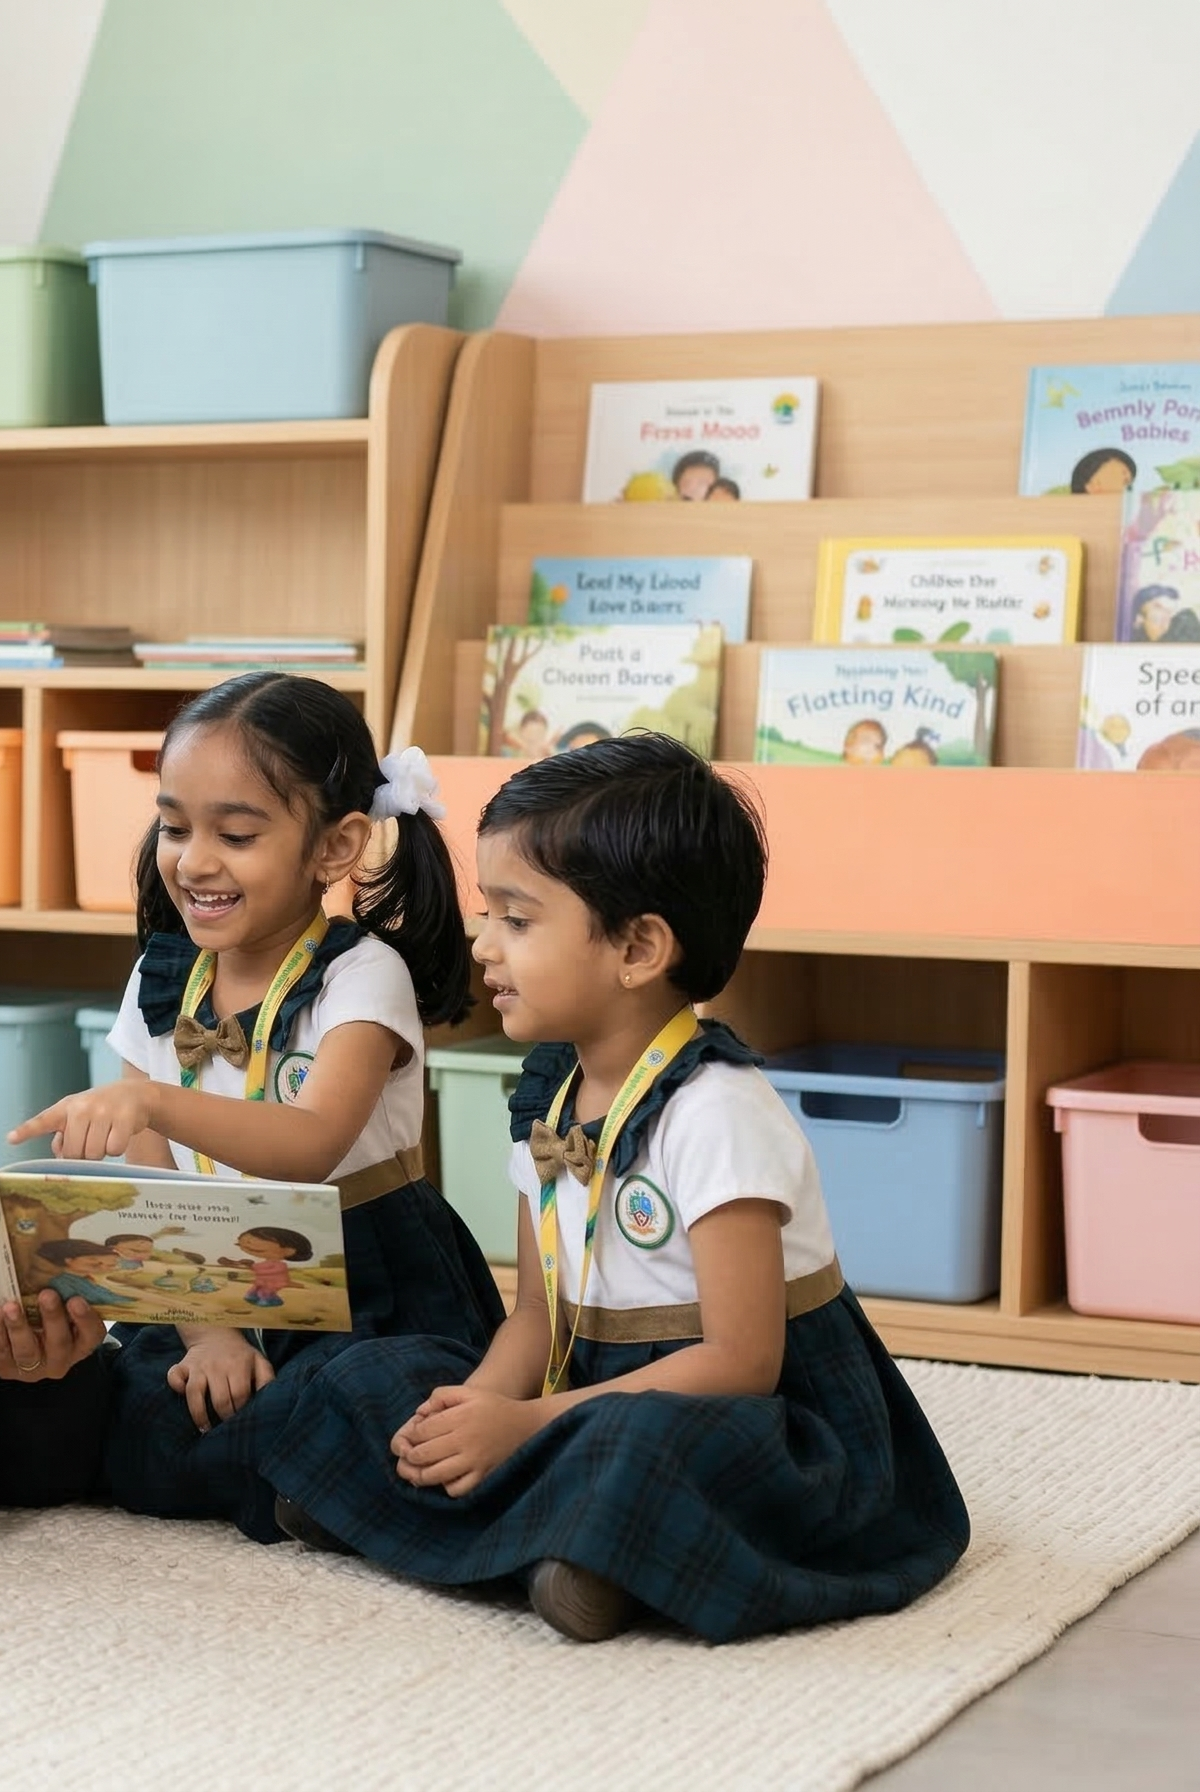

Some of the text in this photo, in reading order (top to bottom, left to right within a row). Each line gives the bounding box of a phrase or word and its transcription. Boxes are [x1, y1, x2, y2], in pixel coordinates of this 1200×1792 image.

[1121, 424, 1191, 442] Babies
[904, 684, 966, 719] Kind
[1136, 697, 1163, 716] of
